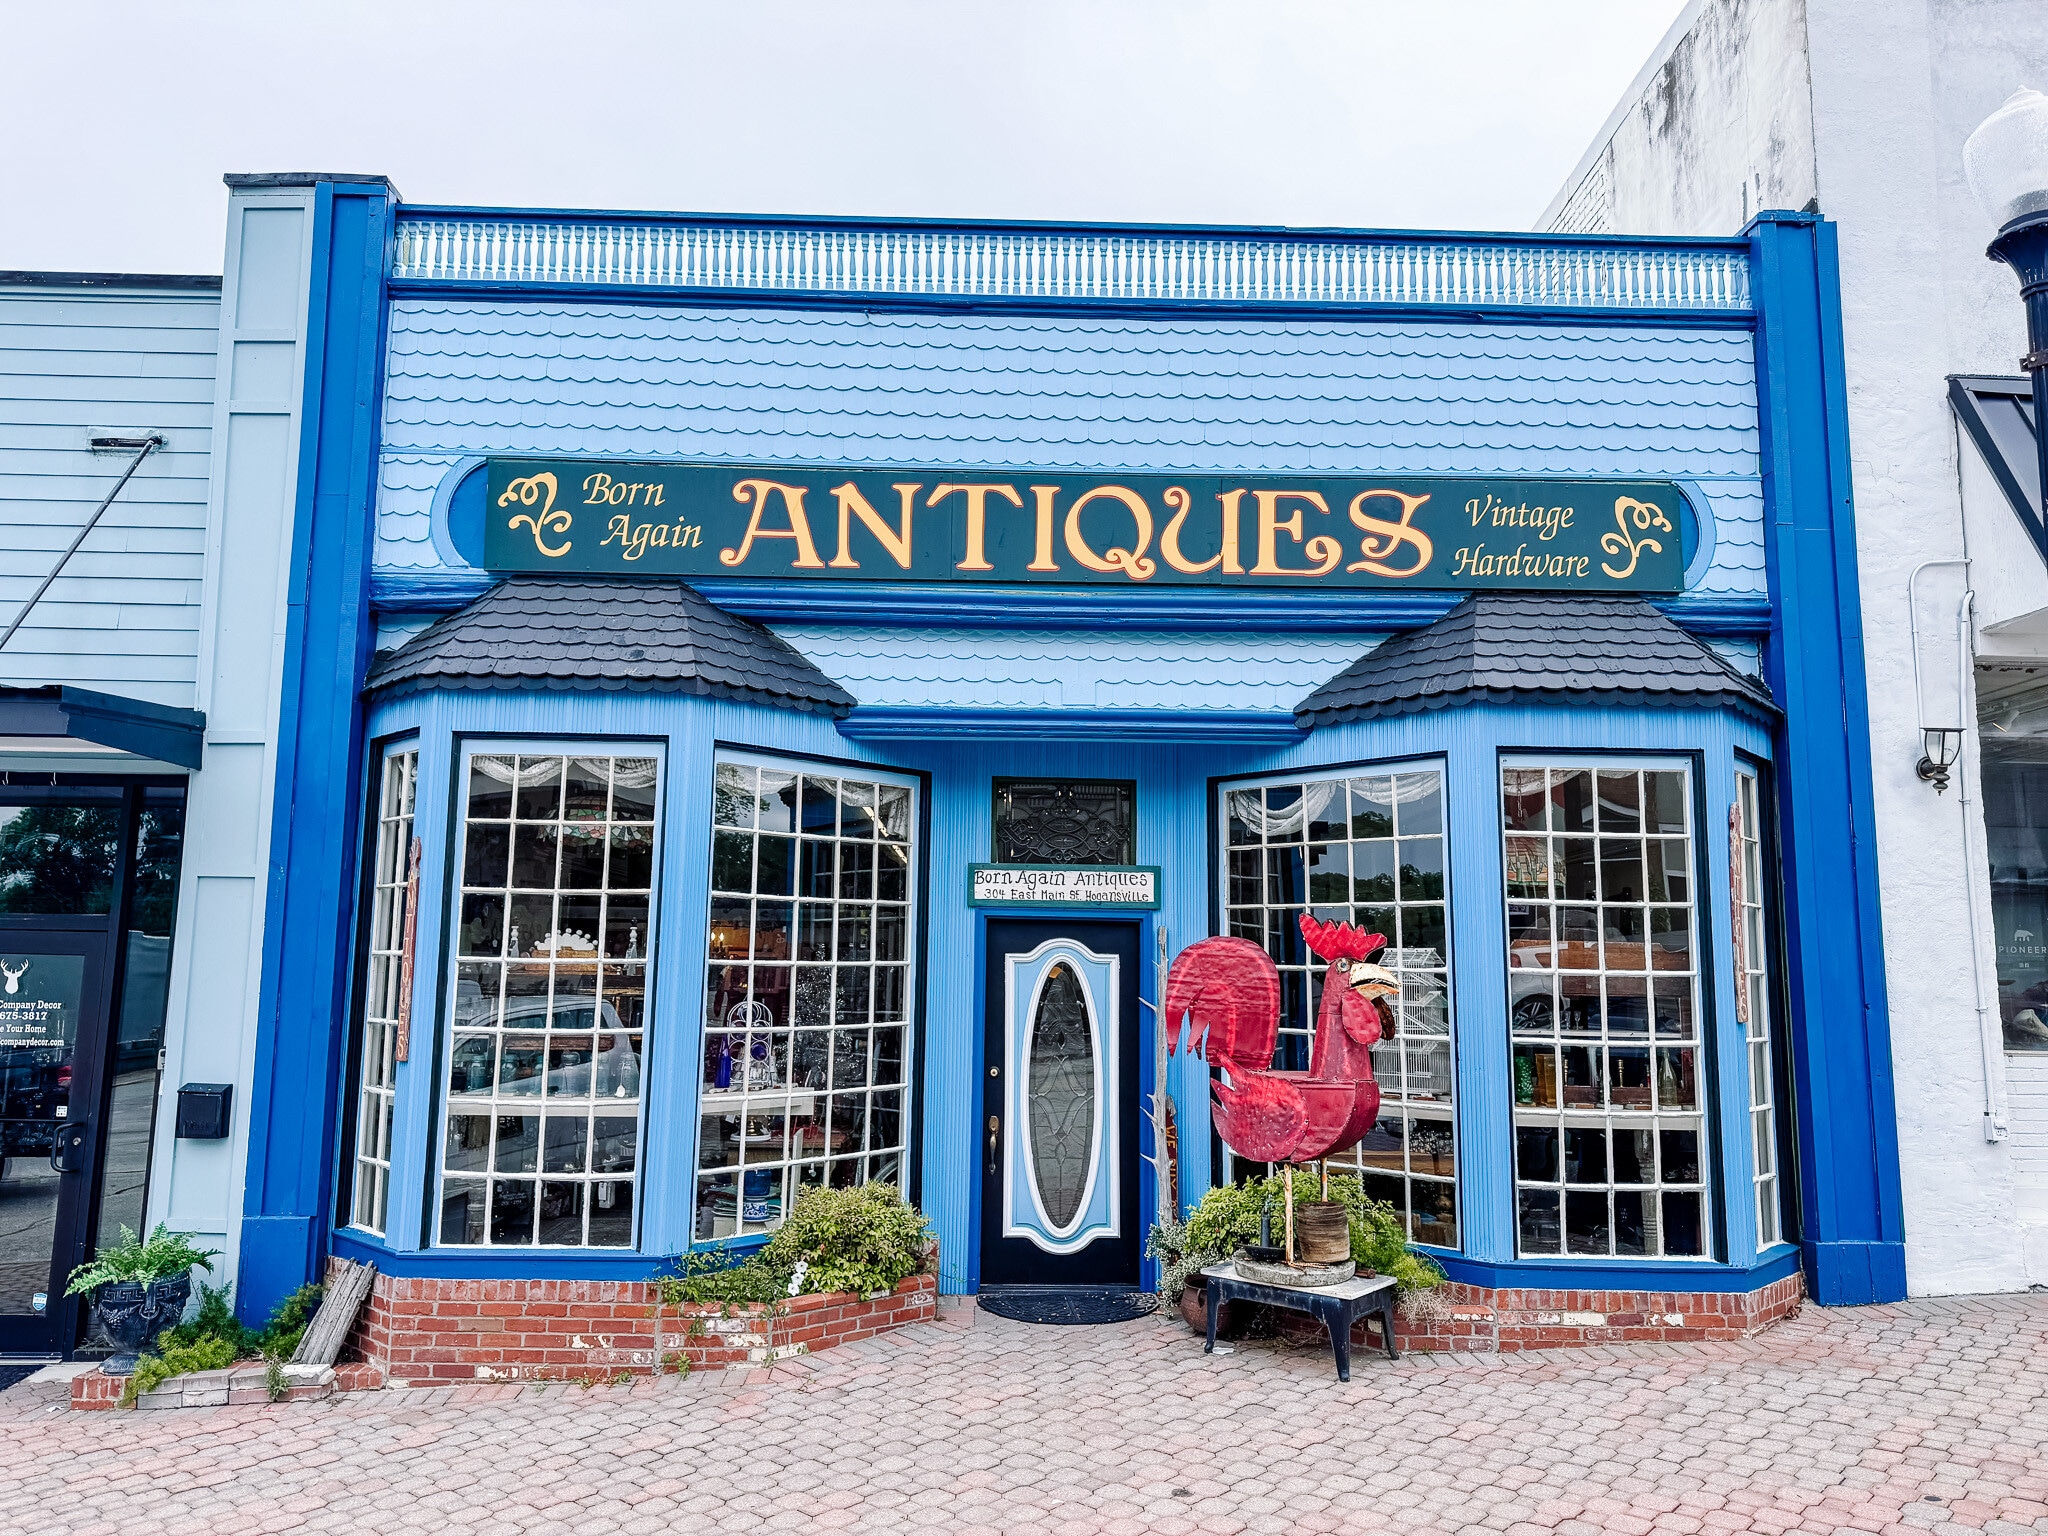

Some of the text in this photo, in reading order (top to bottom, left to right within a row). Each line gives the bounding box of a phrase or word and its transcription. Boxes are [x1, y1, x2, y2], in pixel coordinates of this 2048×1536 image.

[583, 473, 666, 506] Born
[718, 478, 1435, 582] ANTIQUES
[1464, 495, 1575, 541] Vintage
[600, 515, 703, 561] Again
[1452, 543, 1591, 579] Hardware
[974, 870, 1148, 891] Born Again Antiques
[983, 888, 1006, 900] 304
[1010, 888, 1037, 900] East
[1041, 889, 1066, 901] Main
[1085, 889, 1150, 904] Hogansville
[1998, 945, 2047, 954] PIONEER
[397, 870, 416, 1058] ANTIQUES
[0, 1011, 48, 1021] 675-3817
[37, 999, 62, 1010] Decor
[6, 1023, 24, 1033] Your
[24, 1023, 47, 1033] Home
